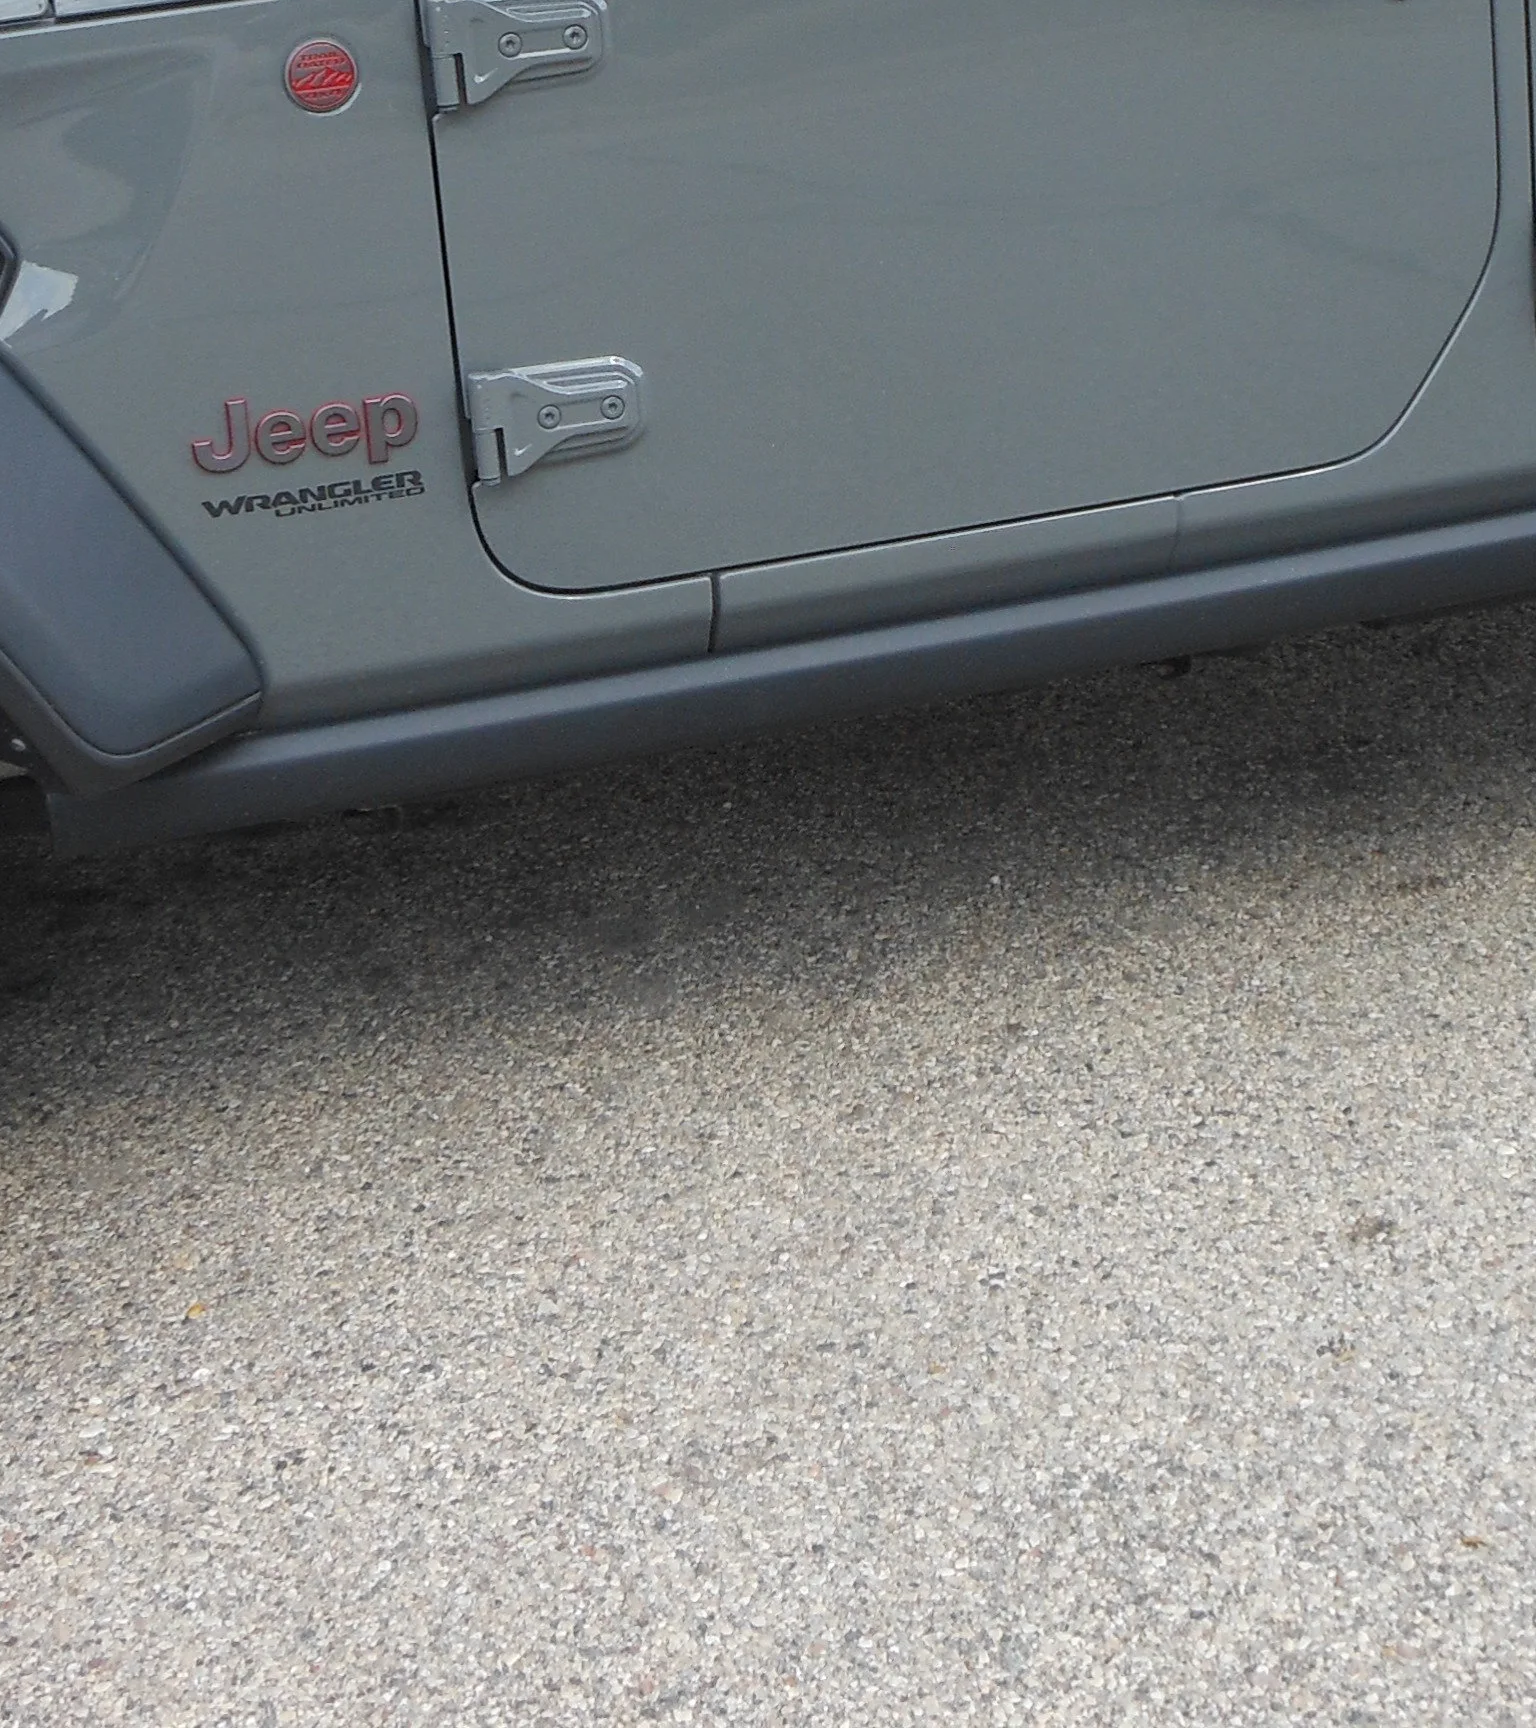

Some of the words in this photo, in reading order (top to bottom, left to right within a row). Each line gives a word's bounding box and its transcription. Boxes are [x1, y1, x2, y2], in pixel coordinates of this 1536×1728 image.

[191, 392, 419, 474] Jeep
[201, 470, 424, 518] WRANGLER
[275, 486, 426, 518] UNLIMITED
